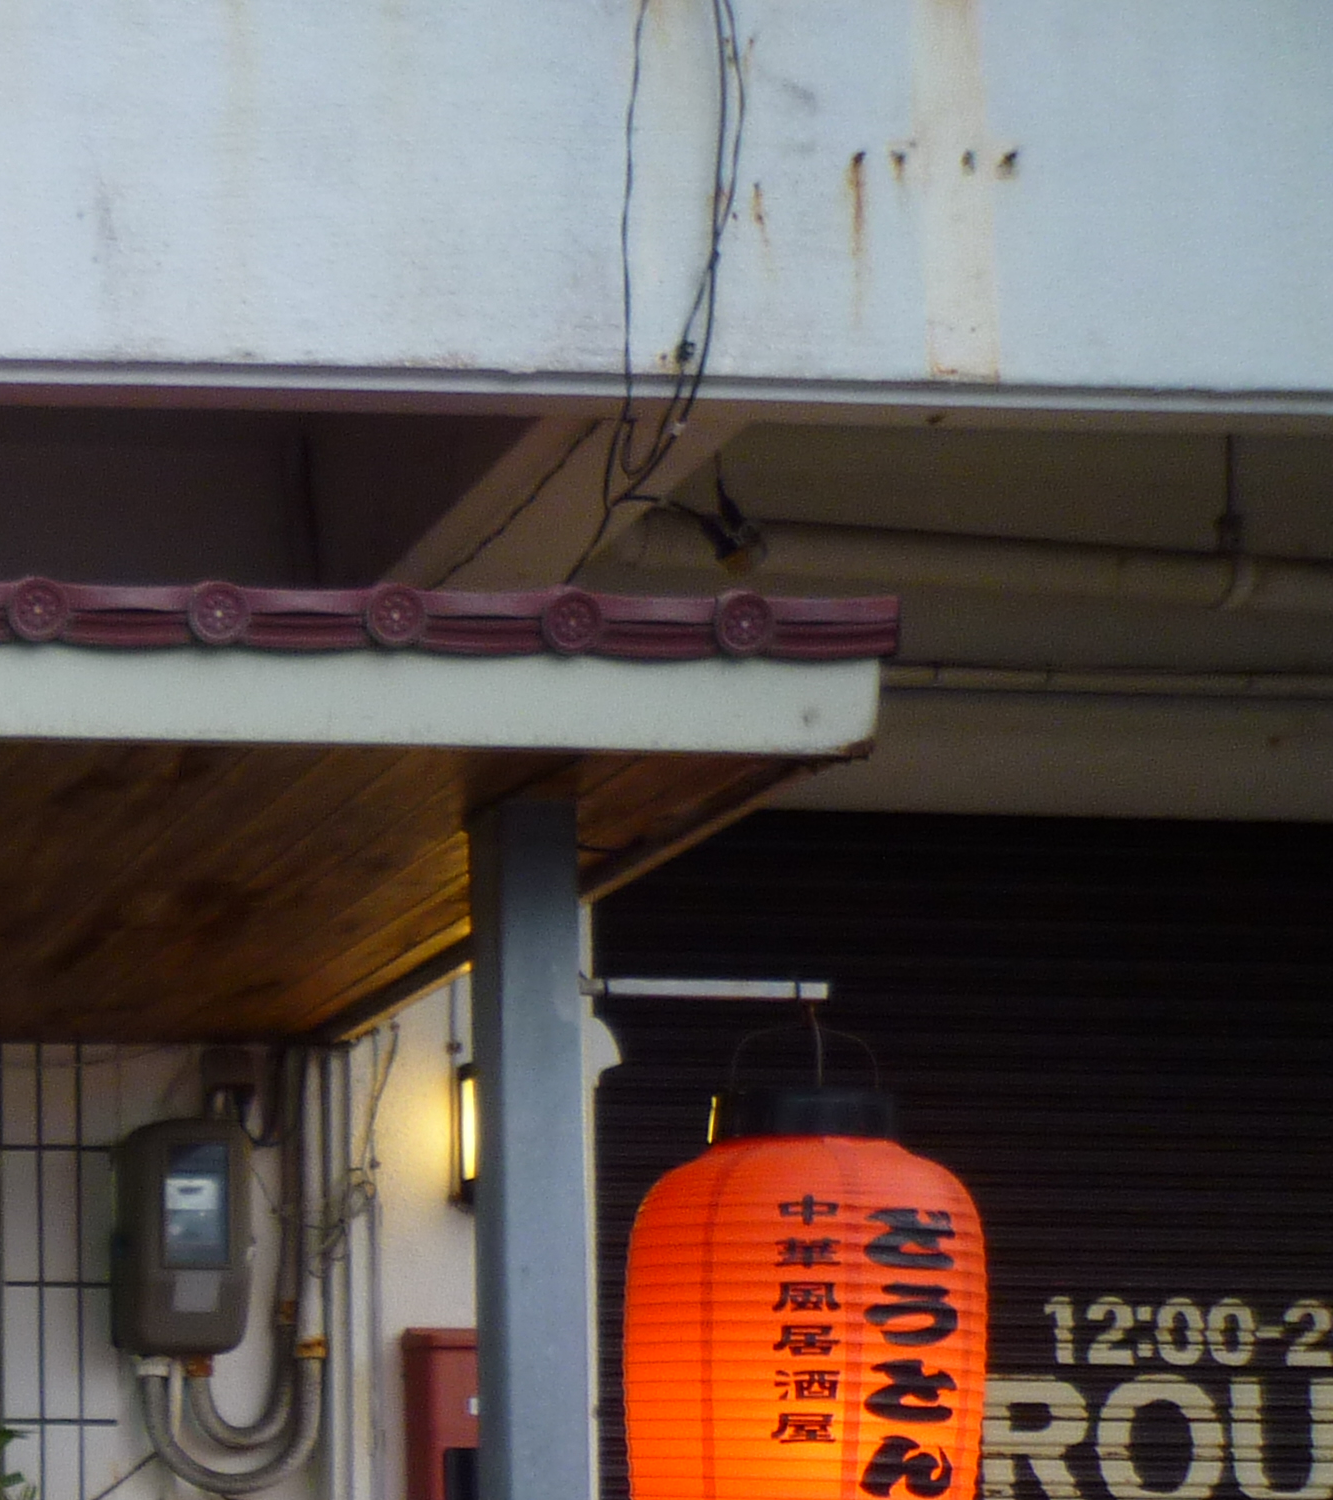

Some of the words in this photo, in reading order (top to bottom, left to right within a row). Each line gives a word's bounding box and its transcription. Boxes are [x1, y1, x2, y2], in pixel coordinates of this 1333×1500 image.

[770, 1194, 841, 1444] 中華風居酒屋
